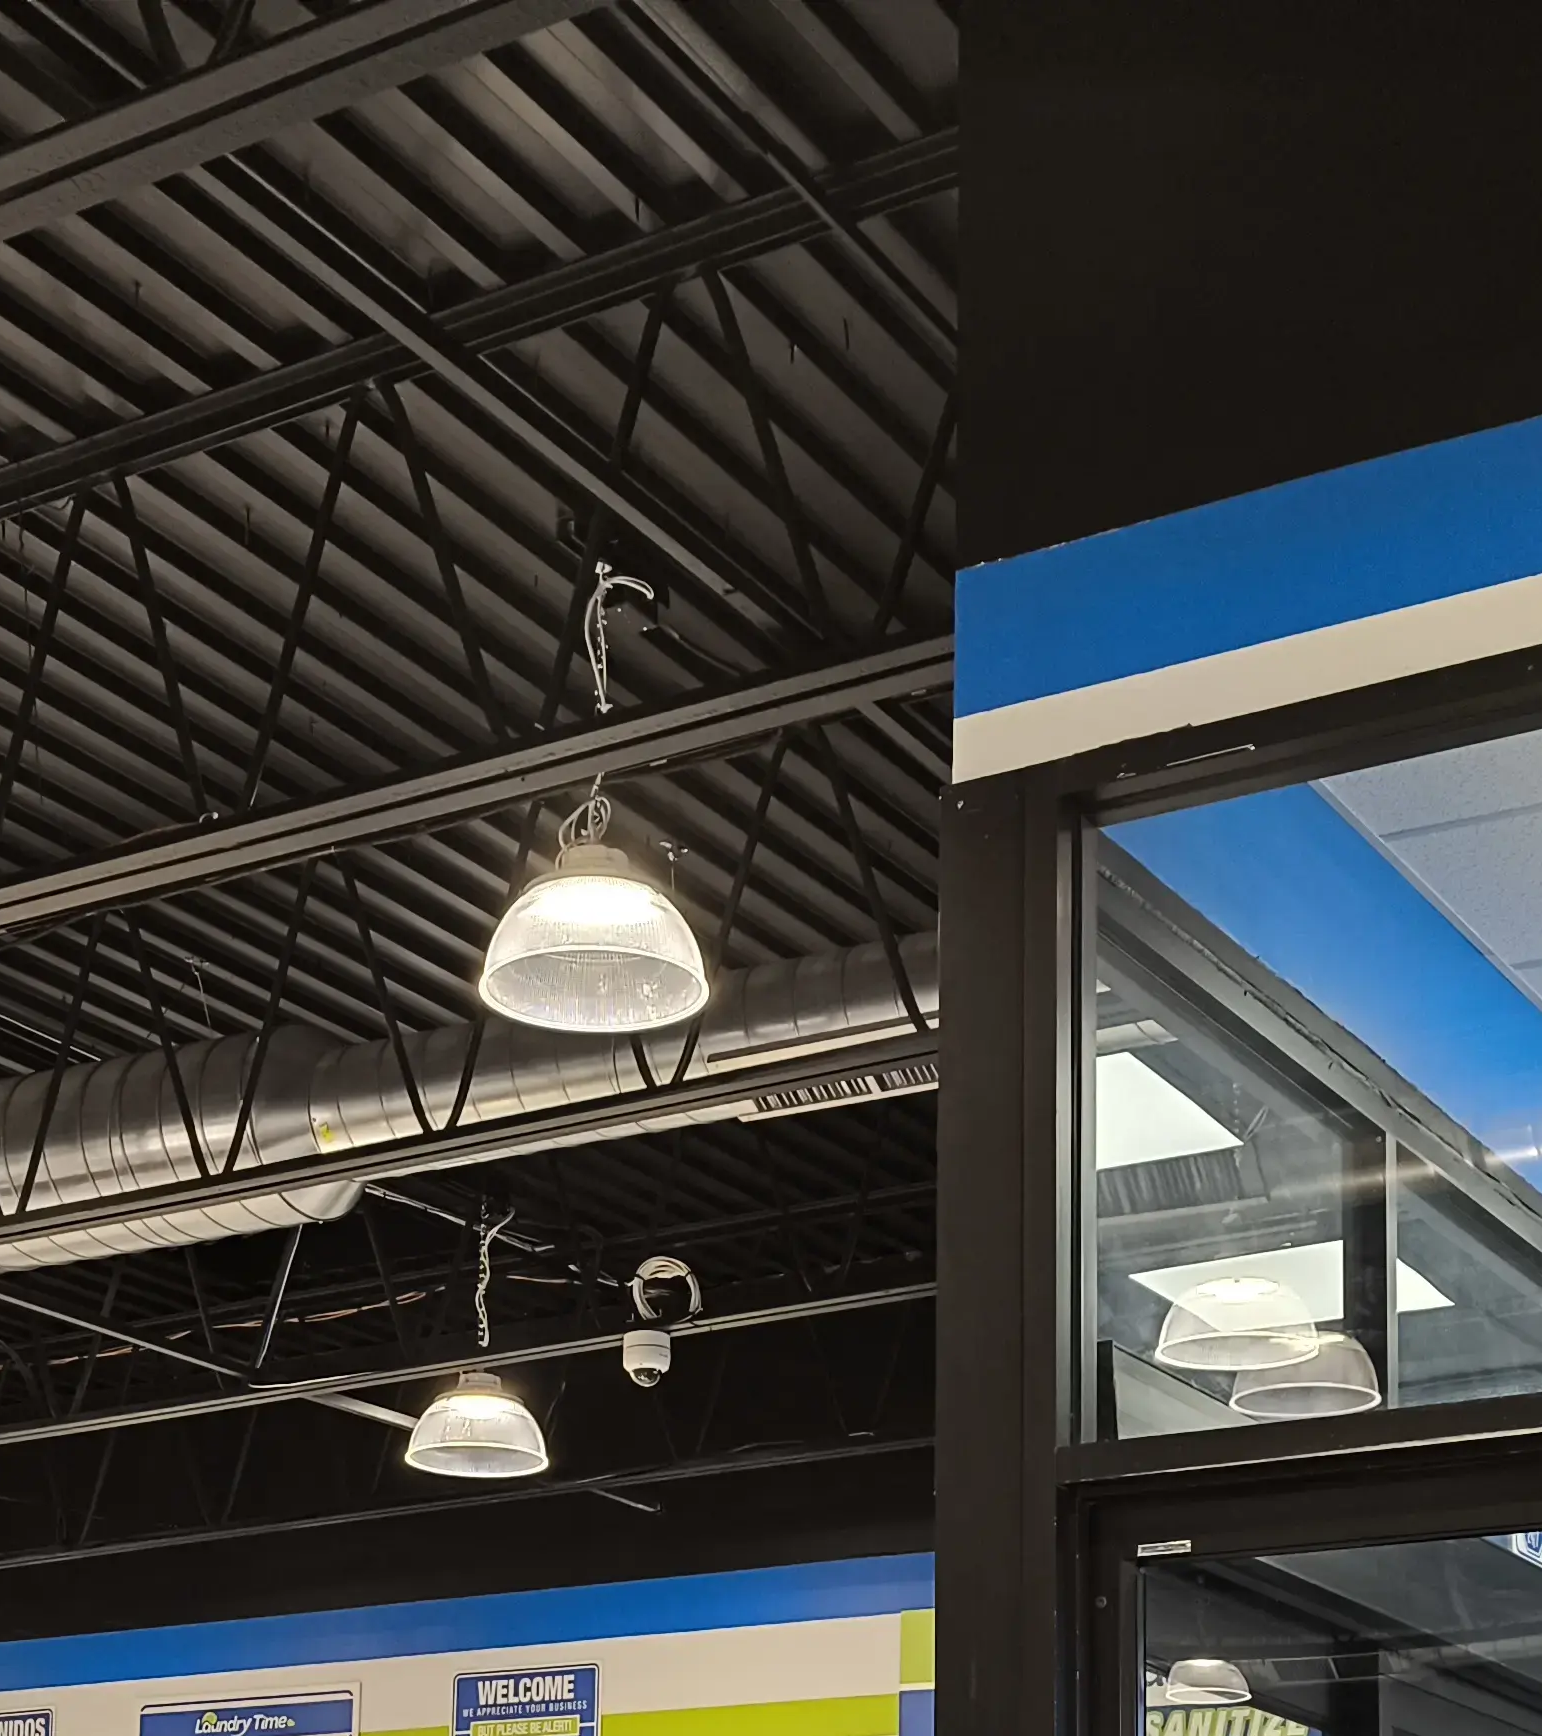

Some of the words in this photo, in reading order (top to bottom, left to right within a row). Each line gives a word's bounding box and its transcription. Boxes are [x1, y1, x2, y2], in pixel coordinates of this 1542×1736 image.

[477, 1674, 575, 1706] WELCOME
[253, 1714, 287, 1730] Time
[478, 1727, 494, 1736] BUT
[496, 1724, 528, 1736] PLEASE
[530, 1723, 541, 1733] BE
[541, 1719, 572, 1733] ALERT!
